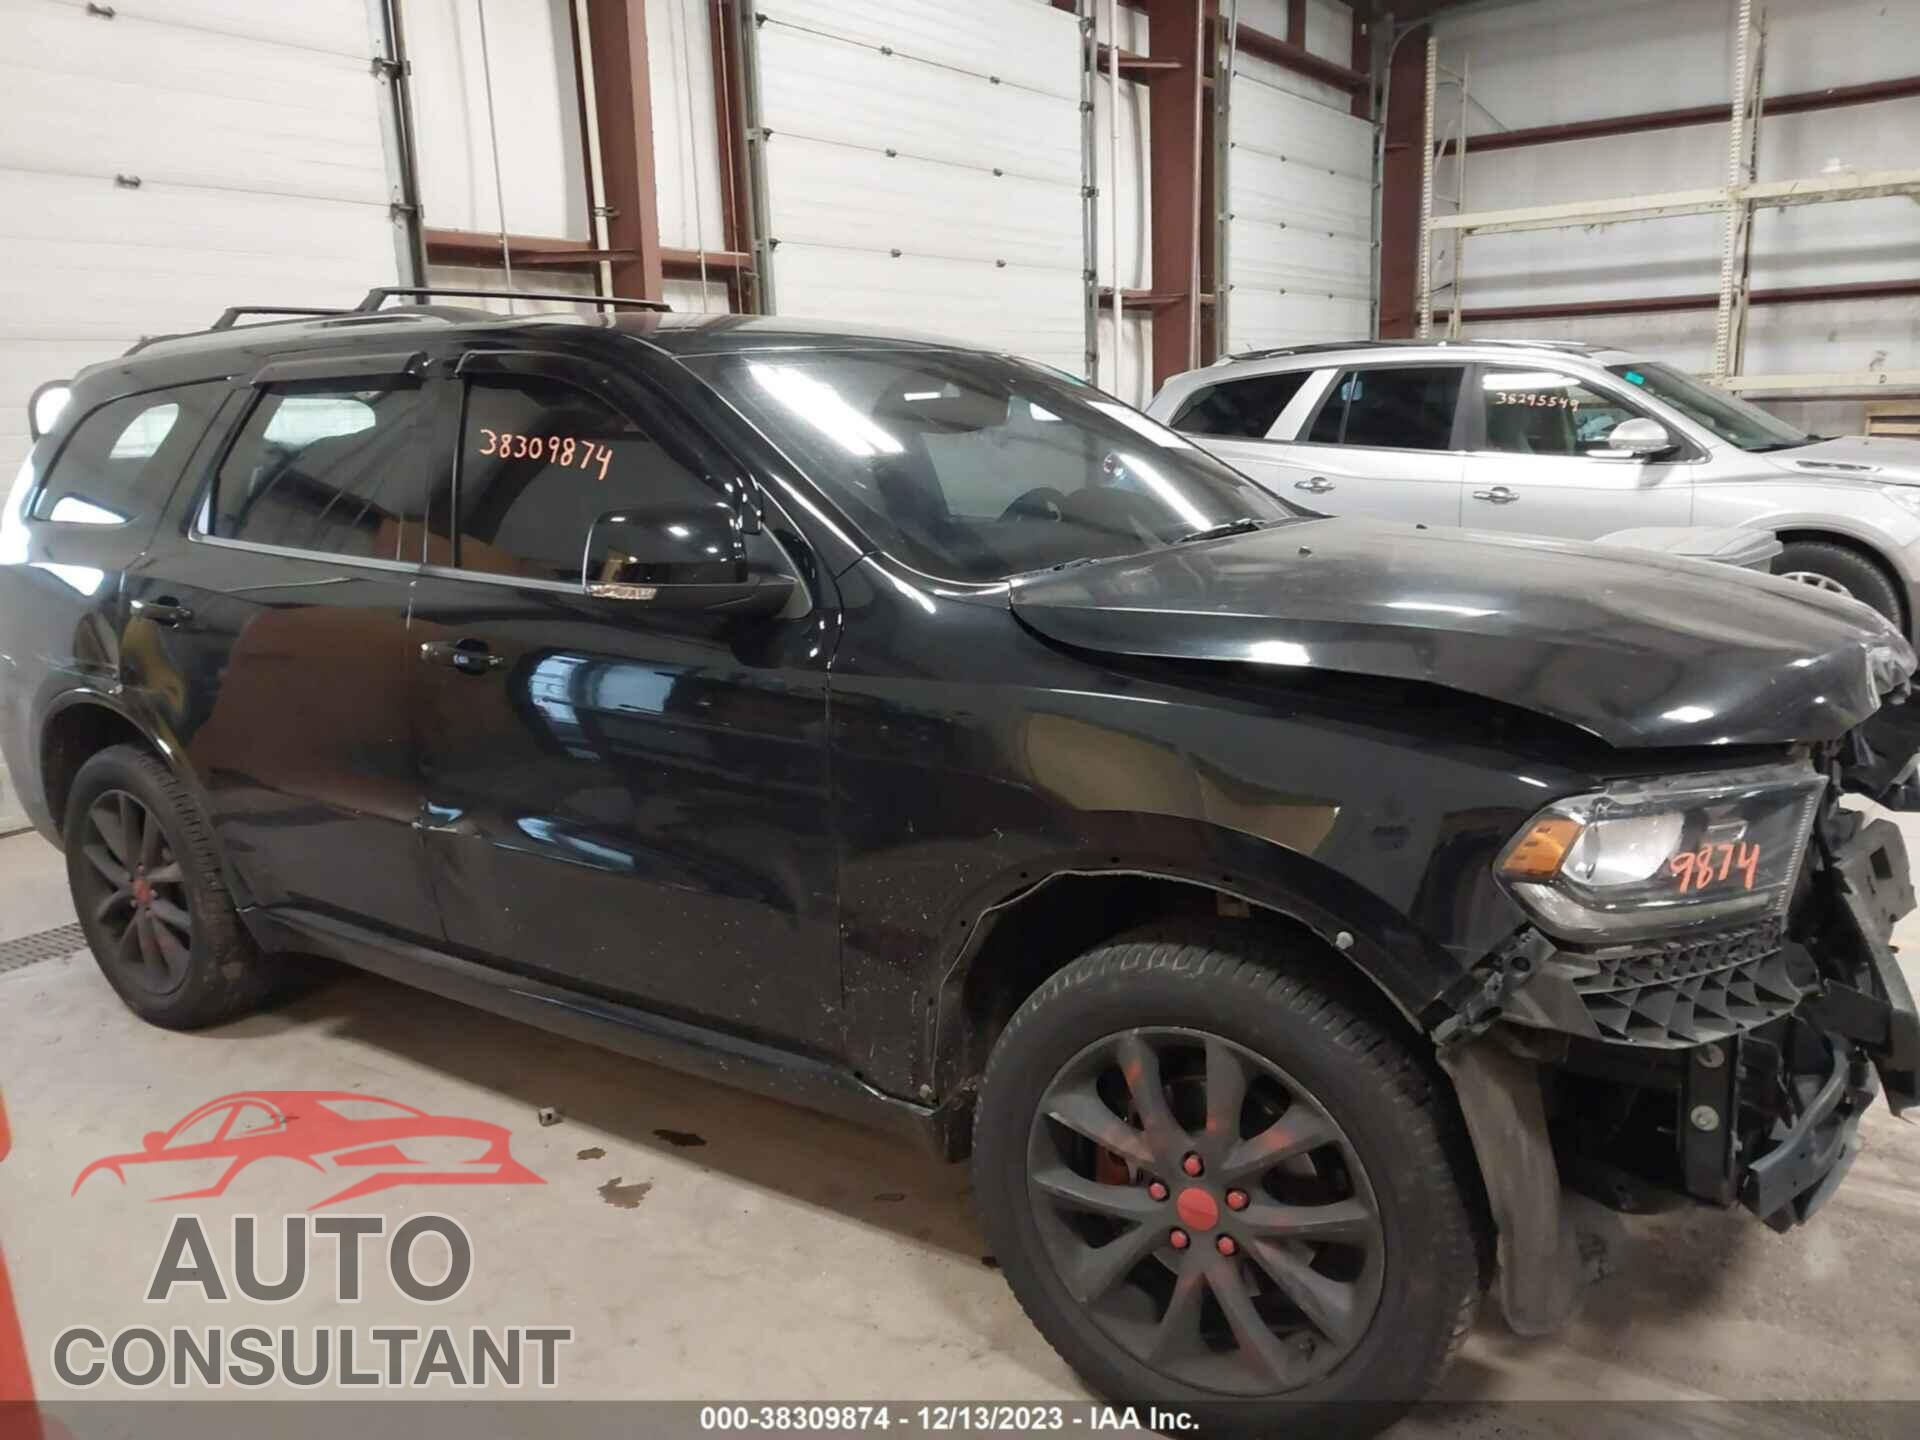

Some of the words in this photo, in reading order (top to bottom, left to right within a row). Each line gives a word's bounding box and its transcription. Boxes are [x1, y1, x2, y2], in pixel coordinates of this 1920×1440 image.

[1495, 391, 1580, 412] 38295549
[479, 428, 613, 481] 38309874
[1669, 841, 1760, 895] 9874
